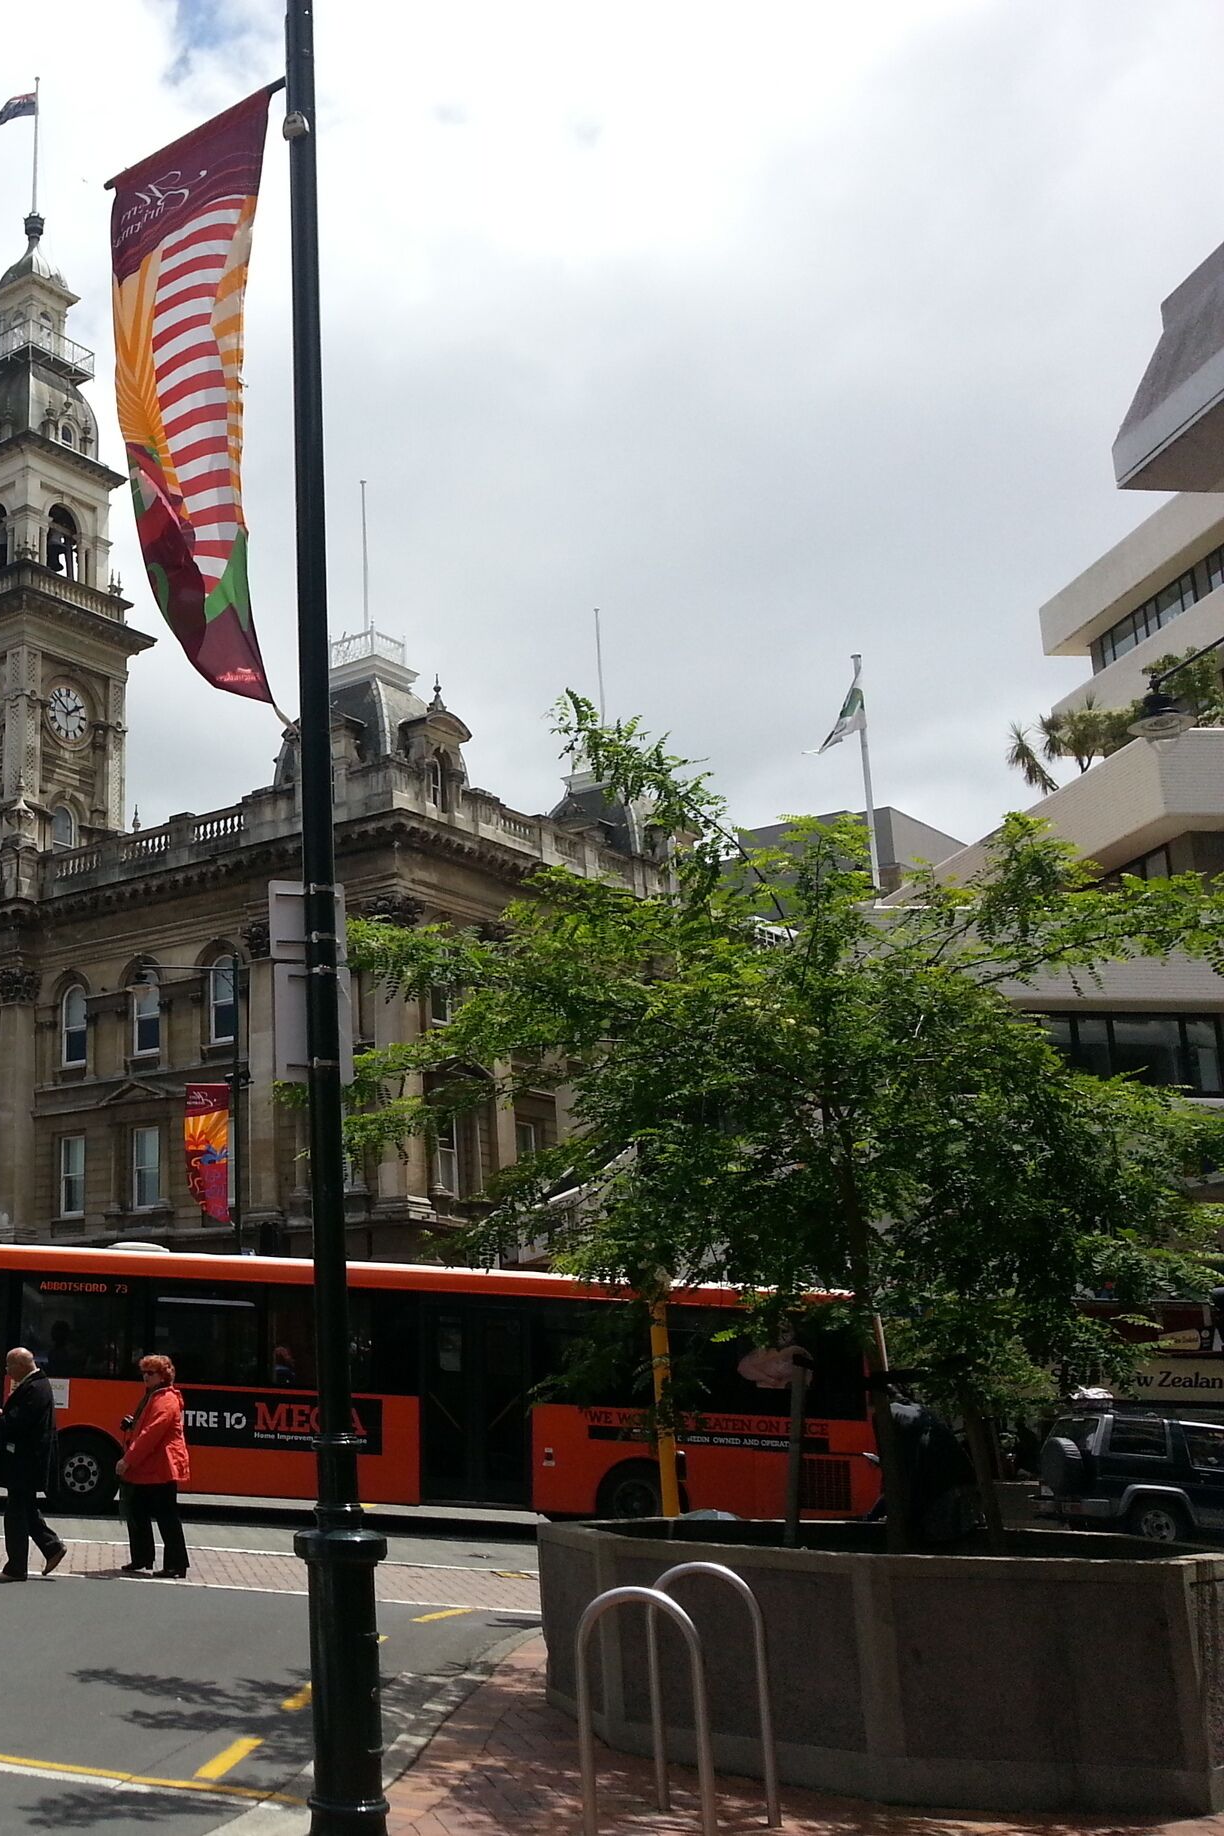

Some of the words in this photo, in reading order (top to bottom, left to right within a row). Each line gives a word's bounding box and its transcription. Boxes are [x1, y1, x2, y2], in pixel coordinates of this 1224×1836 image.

[40, 1281, 107, 1293] ABBOTSFORD
[115, 1284, 128, 1294] 73
[180, 1410, 219, 1428] ITRE
[223, 1412, 247, 1430] 10
[757, 1420, 780, 1433] ON
[254, 1432, 275, 1440] Home
[713, 1437, 741, 1445] OWNED
[743, 1438, 759, 1446] AND
[761, 1440, 791, 1448] OPERAT
